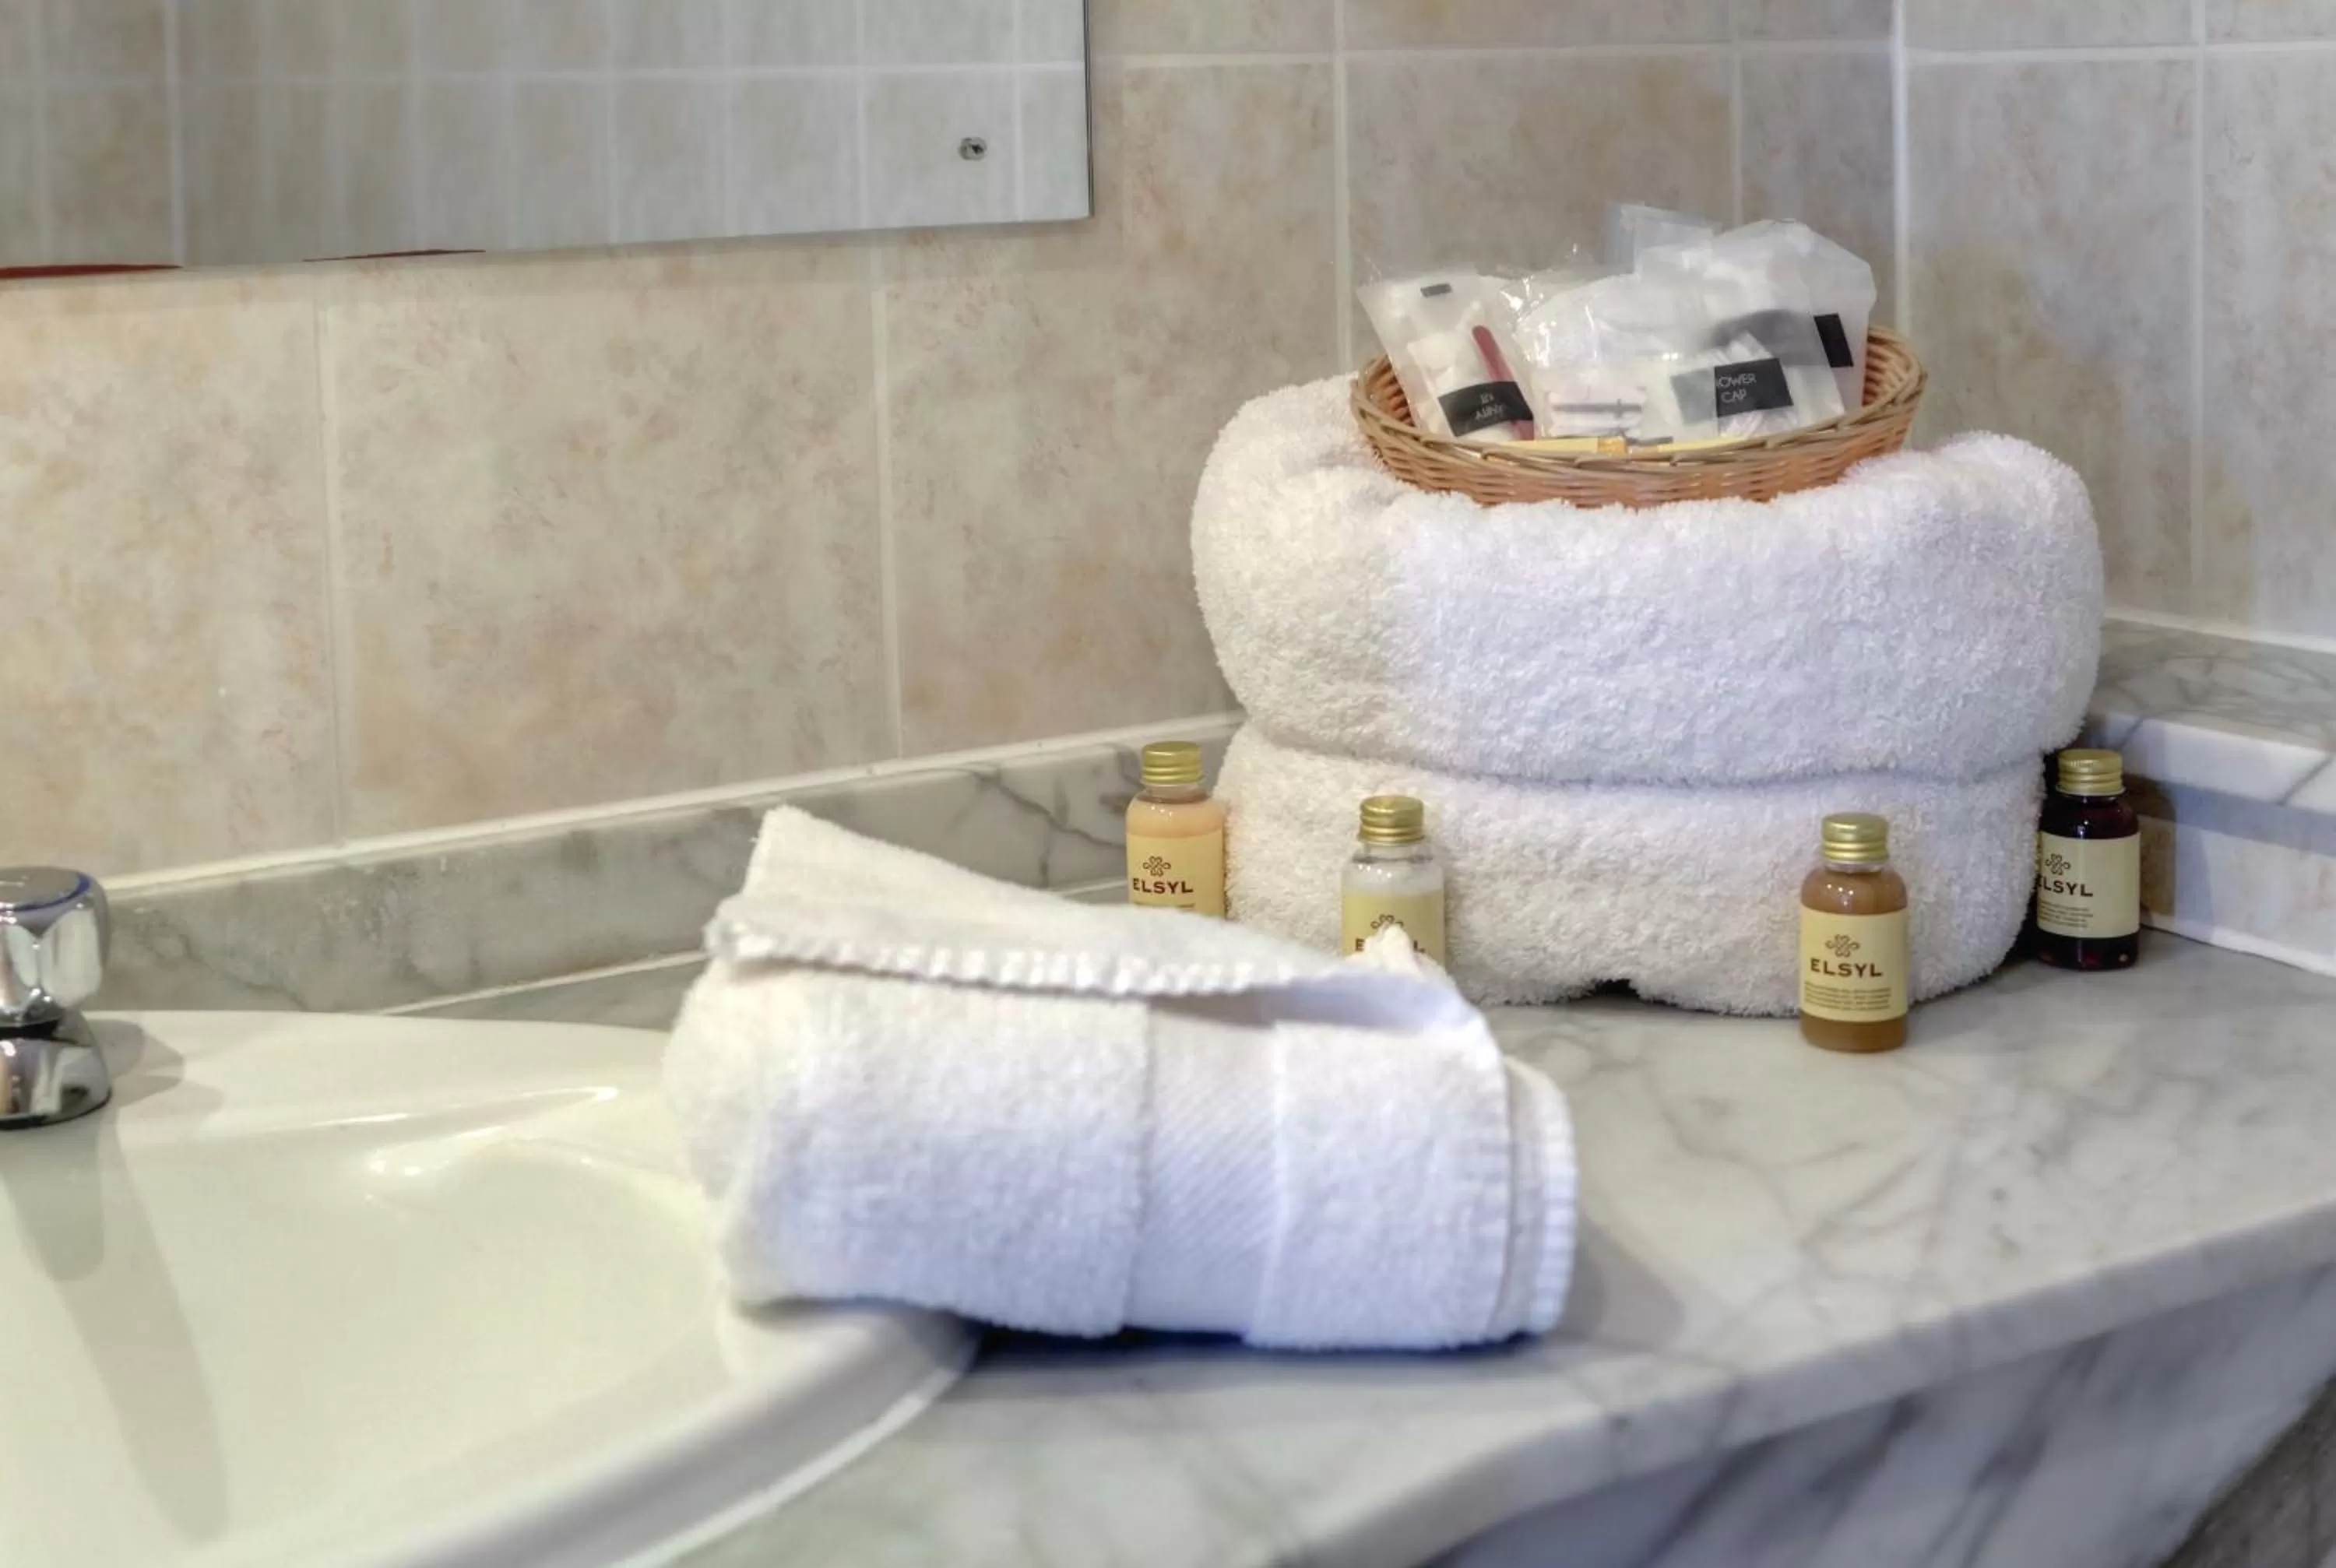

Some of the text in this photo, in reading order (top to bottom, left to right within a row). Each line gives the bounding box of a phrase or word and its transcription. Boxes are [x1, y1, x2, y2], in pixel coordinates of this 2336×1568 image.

[1721, 388, 1747, 403] CAP
[1133, 877, 1194, 895] ELSYL
[1810, 957, 1883, 977] ELSYL
